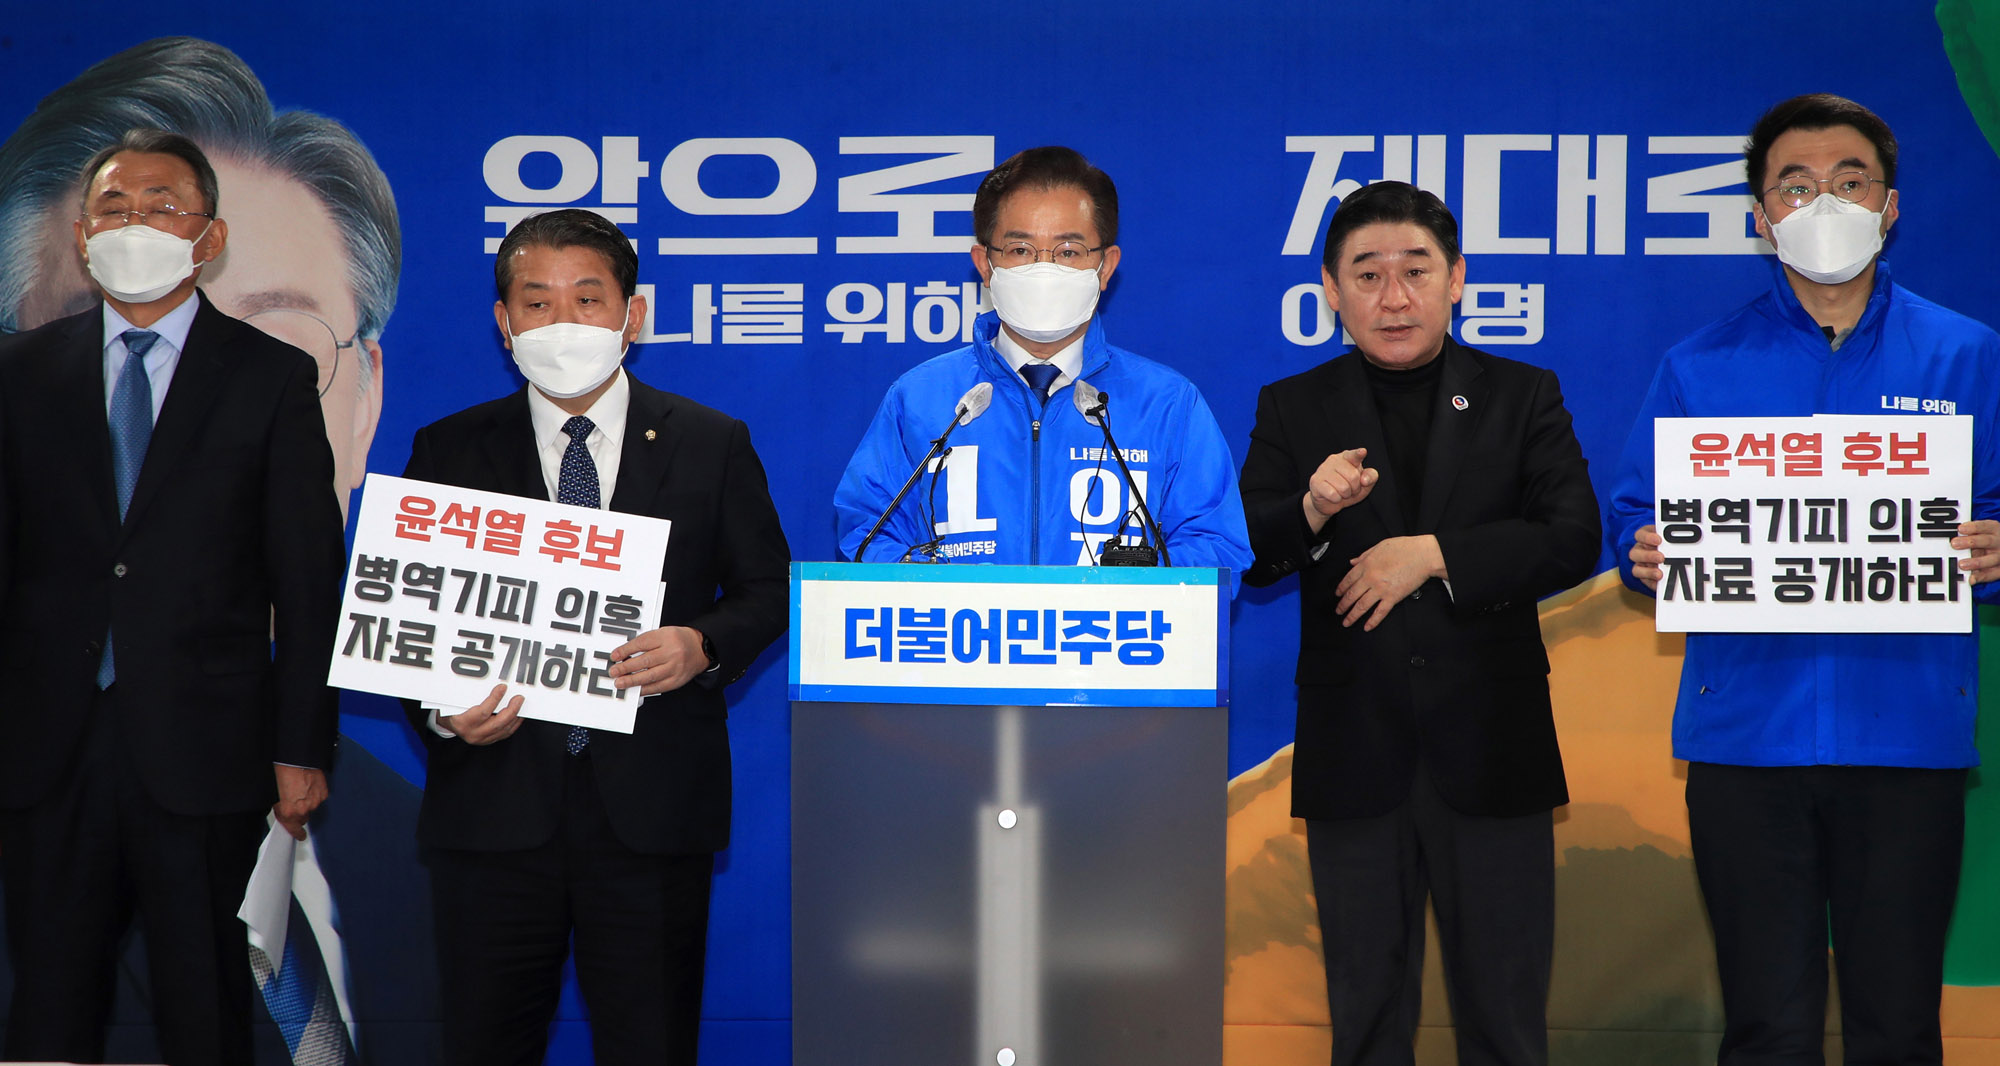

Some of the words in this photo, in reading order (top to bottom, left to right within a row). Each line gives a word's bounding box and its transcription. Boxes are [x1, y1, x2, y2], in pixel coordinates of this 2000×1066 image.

[482, 135, 995, 254] 앞으로
[1281, 134, 1777, 255] 제대로
[634, 283, 803, 345] 나를
[824, 281, 985, 344] 위해
[1281, 283, 1545, 345] 이명
[1881, 395, 1919, 411] 나를
[1921, 399, 1956, 415] 위해
[1069, 447, 1108, 461] 나를
[1690, 432, 1823, 477] 윤석열
[1841, 431, 1930, 477] 후보
[927, 445, 997, 535] 1
[395, 495, 526, 556] 윤석열
[538, 519, 625, 571] 후보
[1660, 498, 1848, 544] 병역기피
[1867, 496, 1962, 543] 의혹
[355, 553, 538, 624] 병역기피
[550, 587, 643, 642] 의혹
[1663, 556, 1756, 602] 자료
[1772, 556, 1965, 603] 공개하라
[341, 612, 437, 669] 자료
[844, 606, 1172, 666] 더불어민주당
